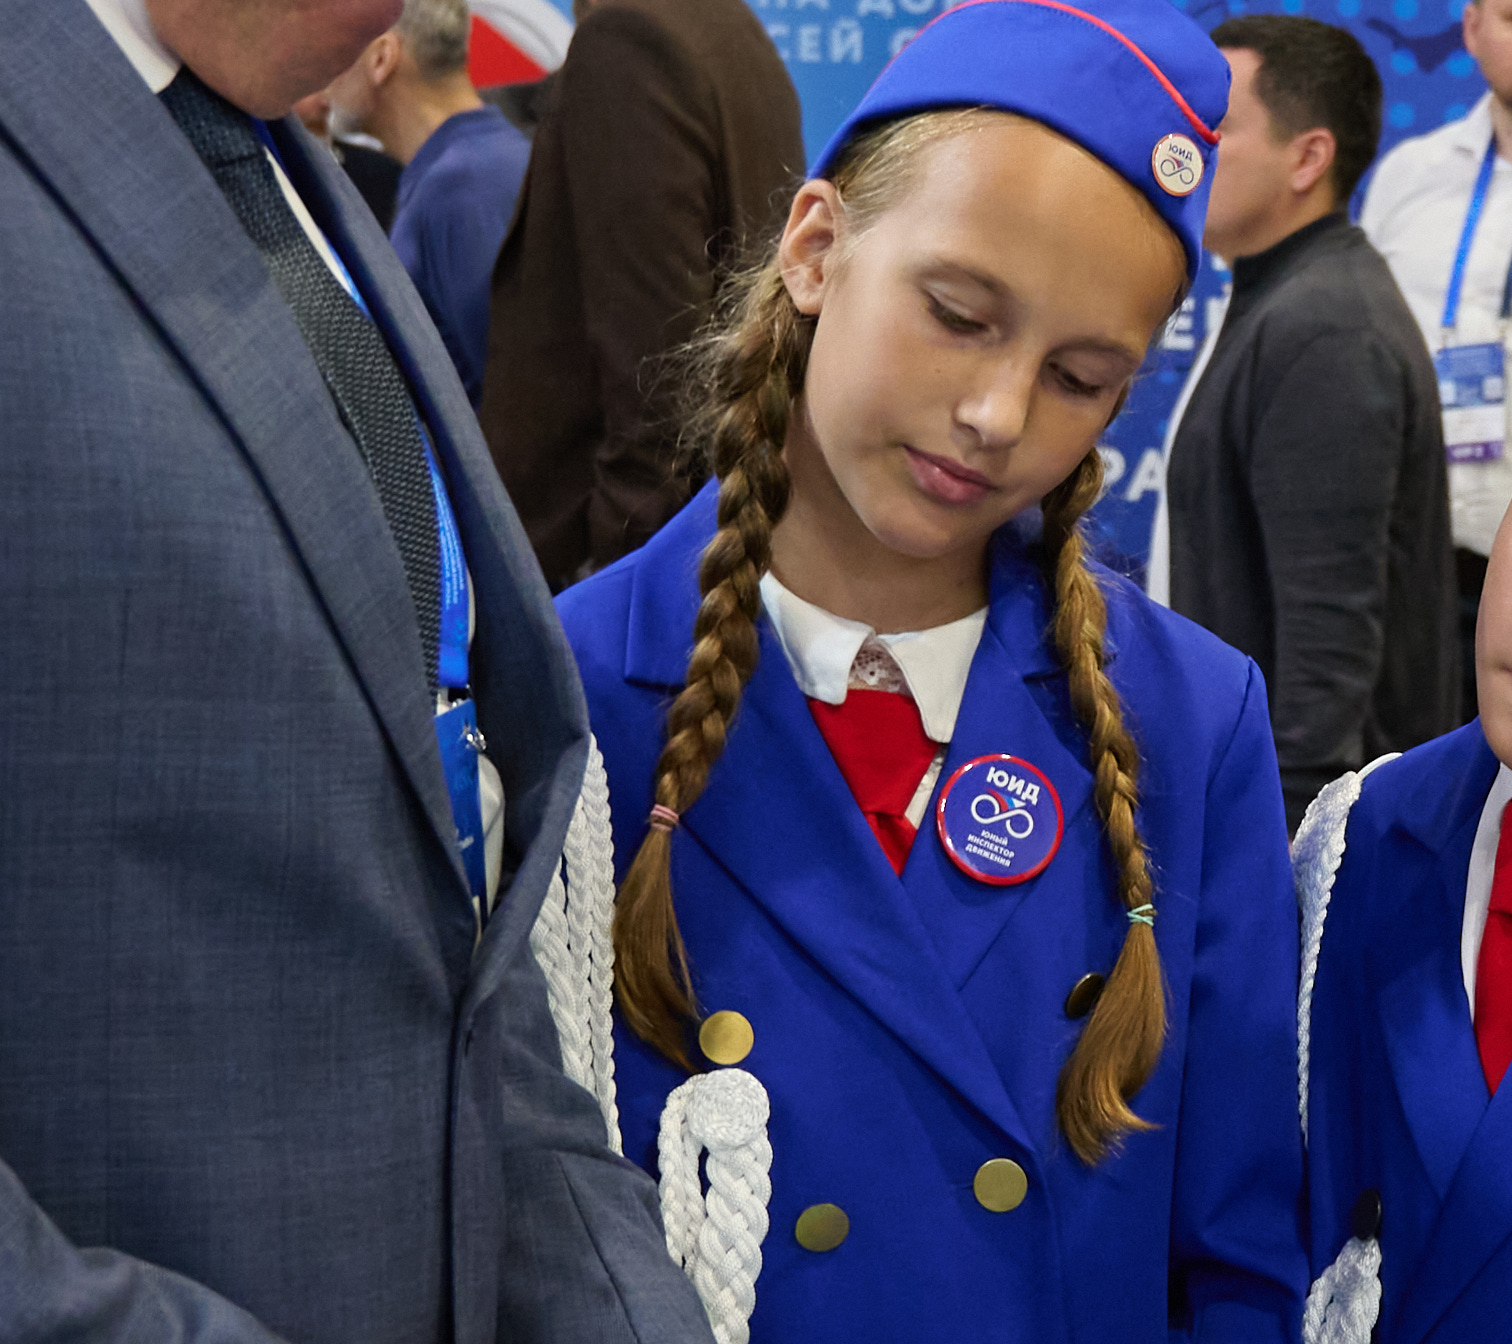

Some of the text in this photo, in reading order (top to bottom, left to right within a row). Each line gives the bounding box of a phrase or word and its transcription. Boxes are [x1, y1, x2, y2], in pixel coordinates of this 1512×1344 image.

[1169, 143, 1192, 162] ЮИД
[986, 766, 1040, 806] ЮИД
[968, 834, 1015, 858] ИНСПЕКТОР
[981, 830, 1008, 846] ЮНЫЙ
[965, 843, 1011, 867] ДВИЖЕНИЯ
